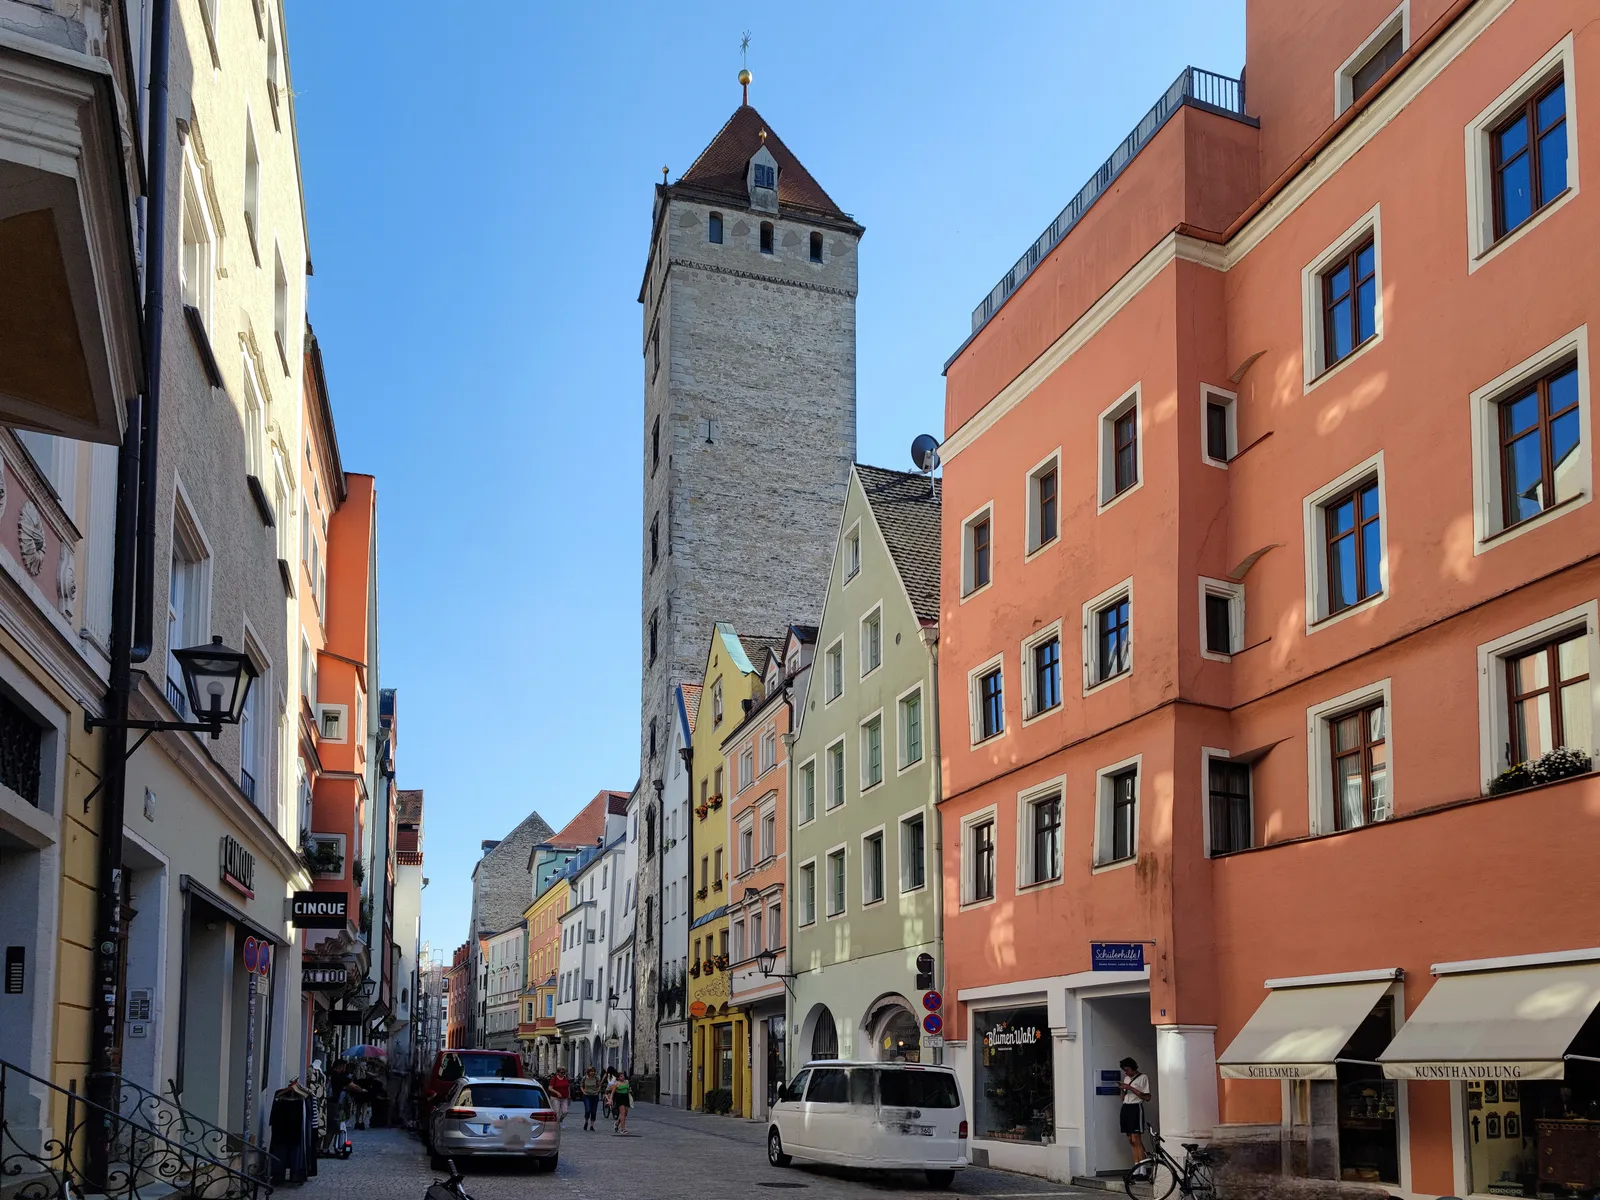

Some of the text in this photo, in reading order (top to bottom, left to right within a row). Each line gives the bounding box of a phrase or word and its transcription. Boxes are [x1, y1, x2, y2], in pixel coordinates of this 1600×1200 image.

[224, 834, 255, 892] CINQUE
[294, 902, 346, 915] CINQUE
[302, 968, 346, 984] ATTOO
[1248, 1065, 1300, 1078] SCHLEMMER
[1414, 1065, 1521, 1078] KUNSTHANDLUNG
